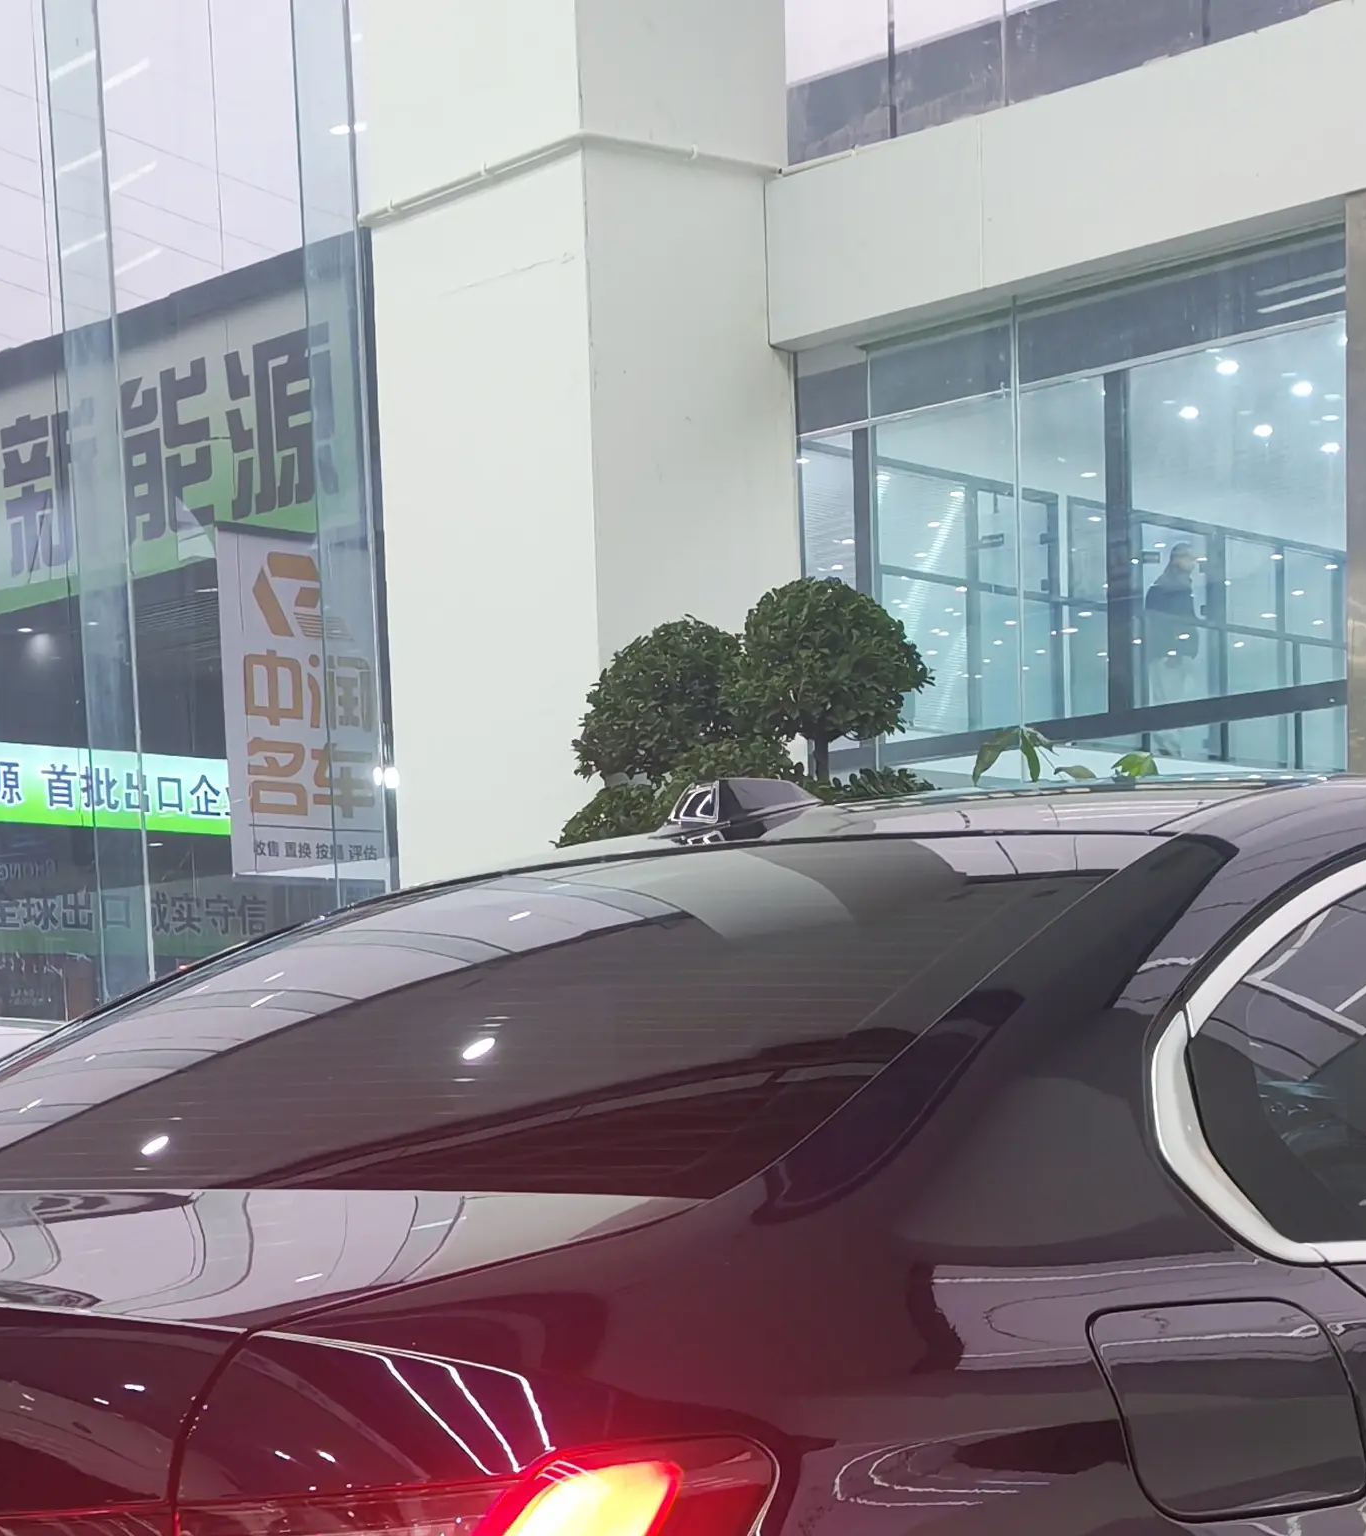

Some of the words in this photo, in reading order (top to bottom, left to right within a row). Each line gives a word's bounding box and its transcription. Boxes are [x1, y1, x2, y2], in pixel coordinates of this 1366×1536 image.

[244, 649, 372, 733] 中润
[247, 737, 375, 819] 名车
[348, 844, 378, 861] 评估
